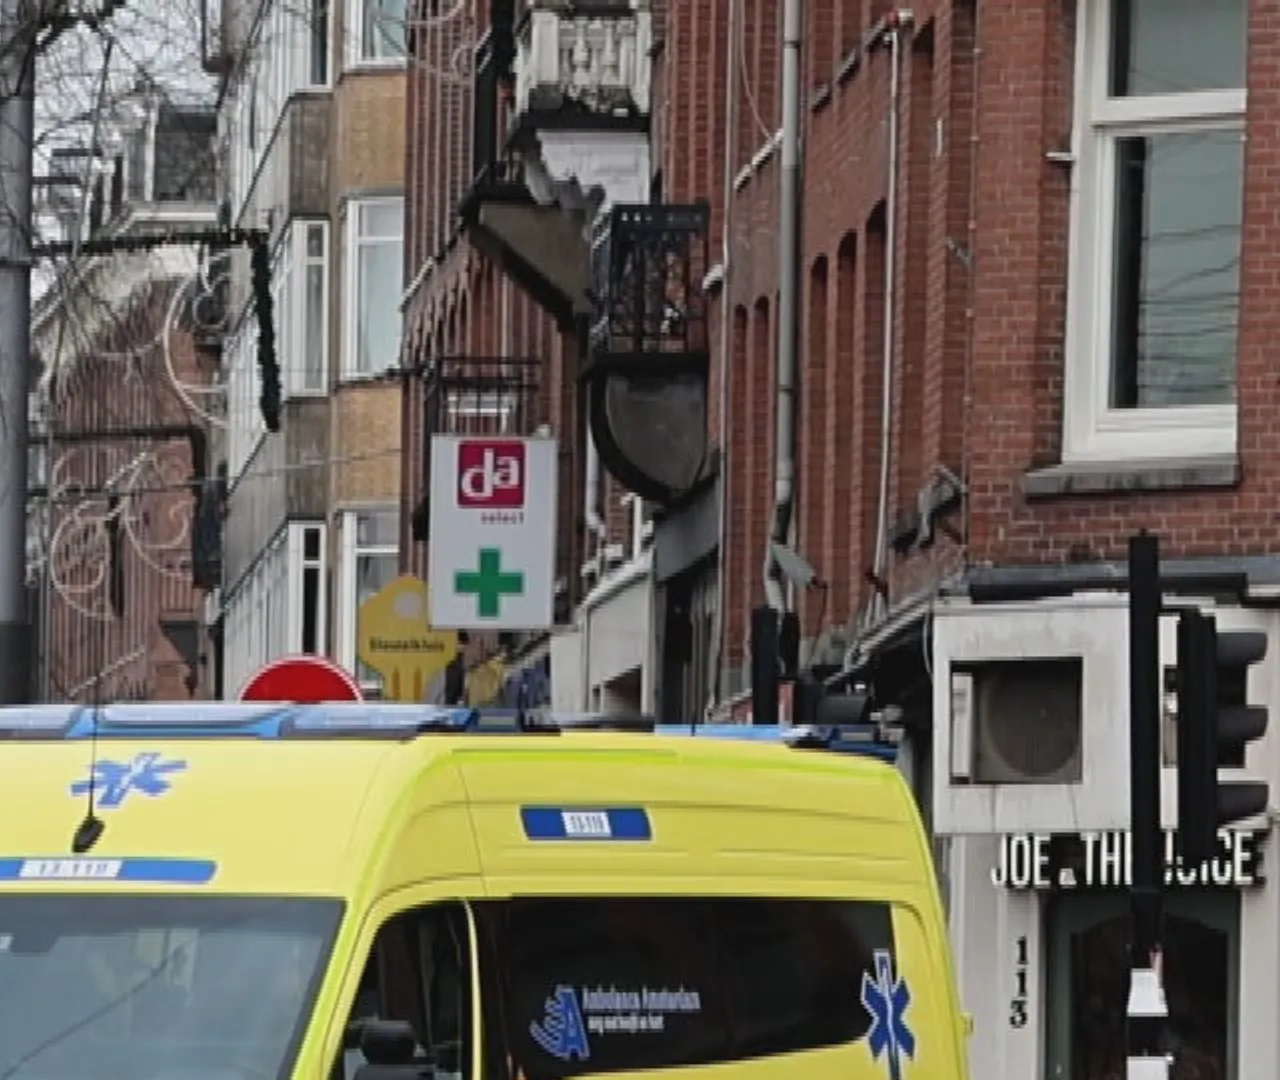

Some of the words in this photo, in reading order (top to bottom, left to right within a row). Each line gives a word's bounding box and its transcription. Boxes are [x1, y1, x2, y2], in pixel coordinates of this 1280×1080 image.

[462, 448, 520, 498] da
[991, 833, 1051, 886] JOE
[1009, 936, 1029, 1028] 113
